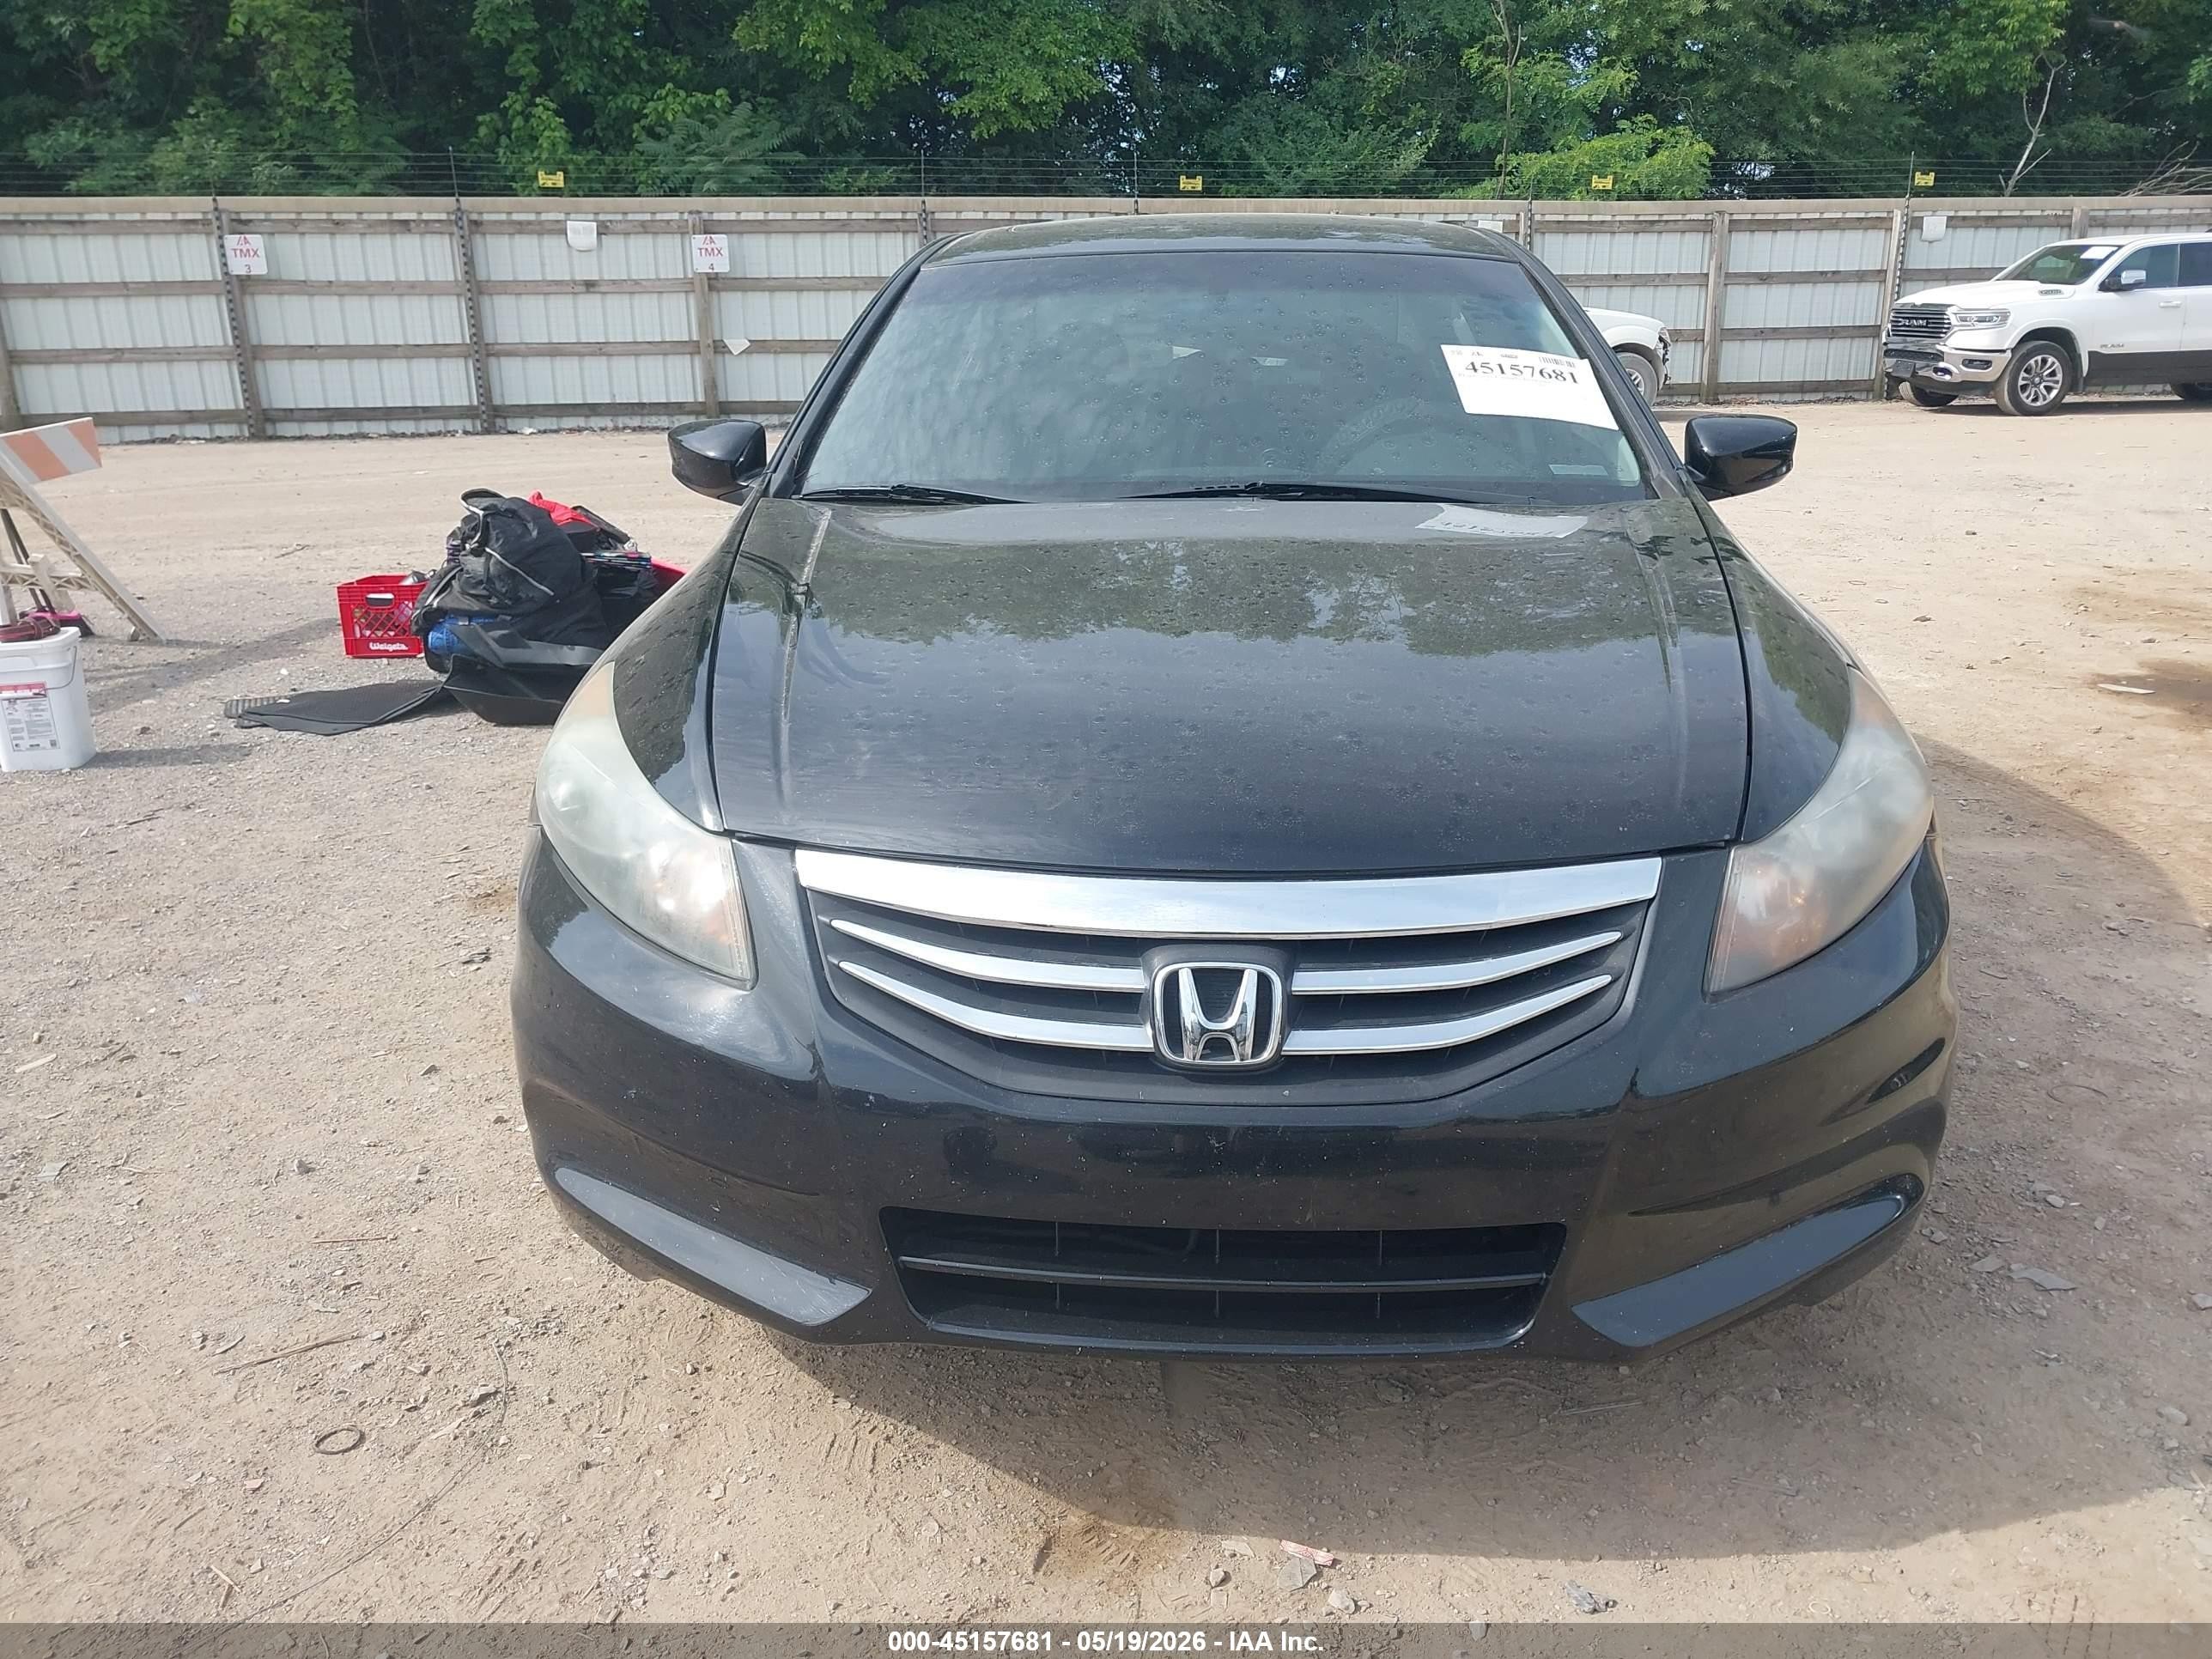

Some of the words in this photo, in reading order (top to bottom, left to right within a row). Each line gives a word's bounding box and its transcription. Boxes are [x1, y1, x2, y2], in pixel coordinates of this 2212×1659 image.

[231, 247, 259, 258] TMX
[697, 246, 723, 258] TMX
[244, 264, 252, 274] 3
[708, 263, 715, 272] 4
[1465, 361, 1579, 385] 45157681
